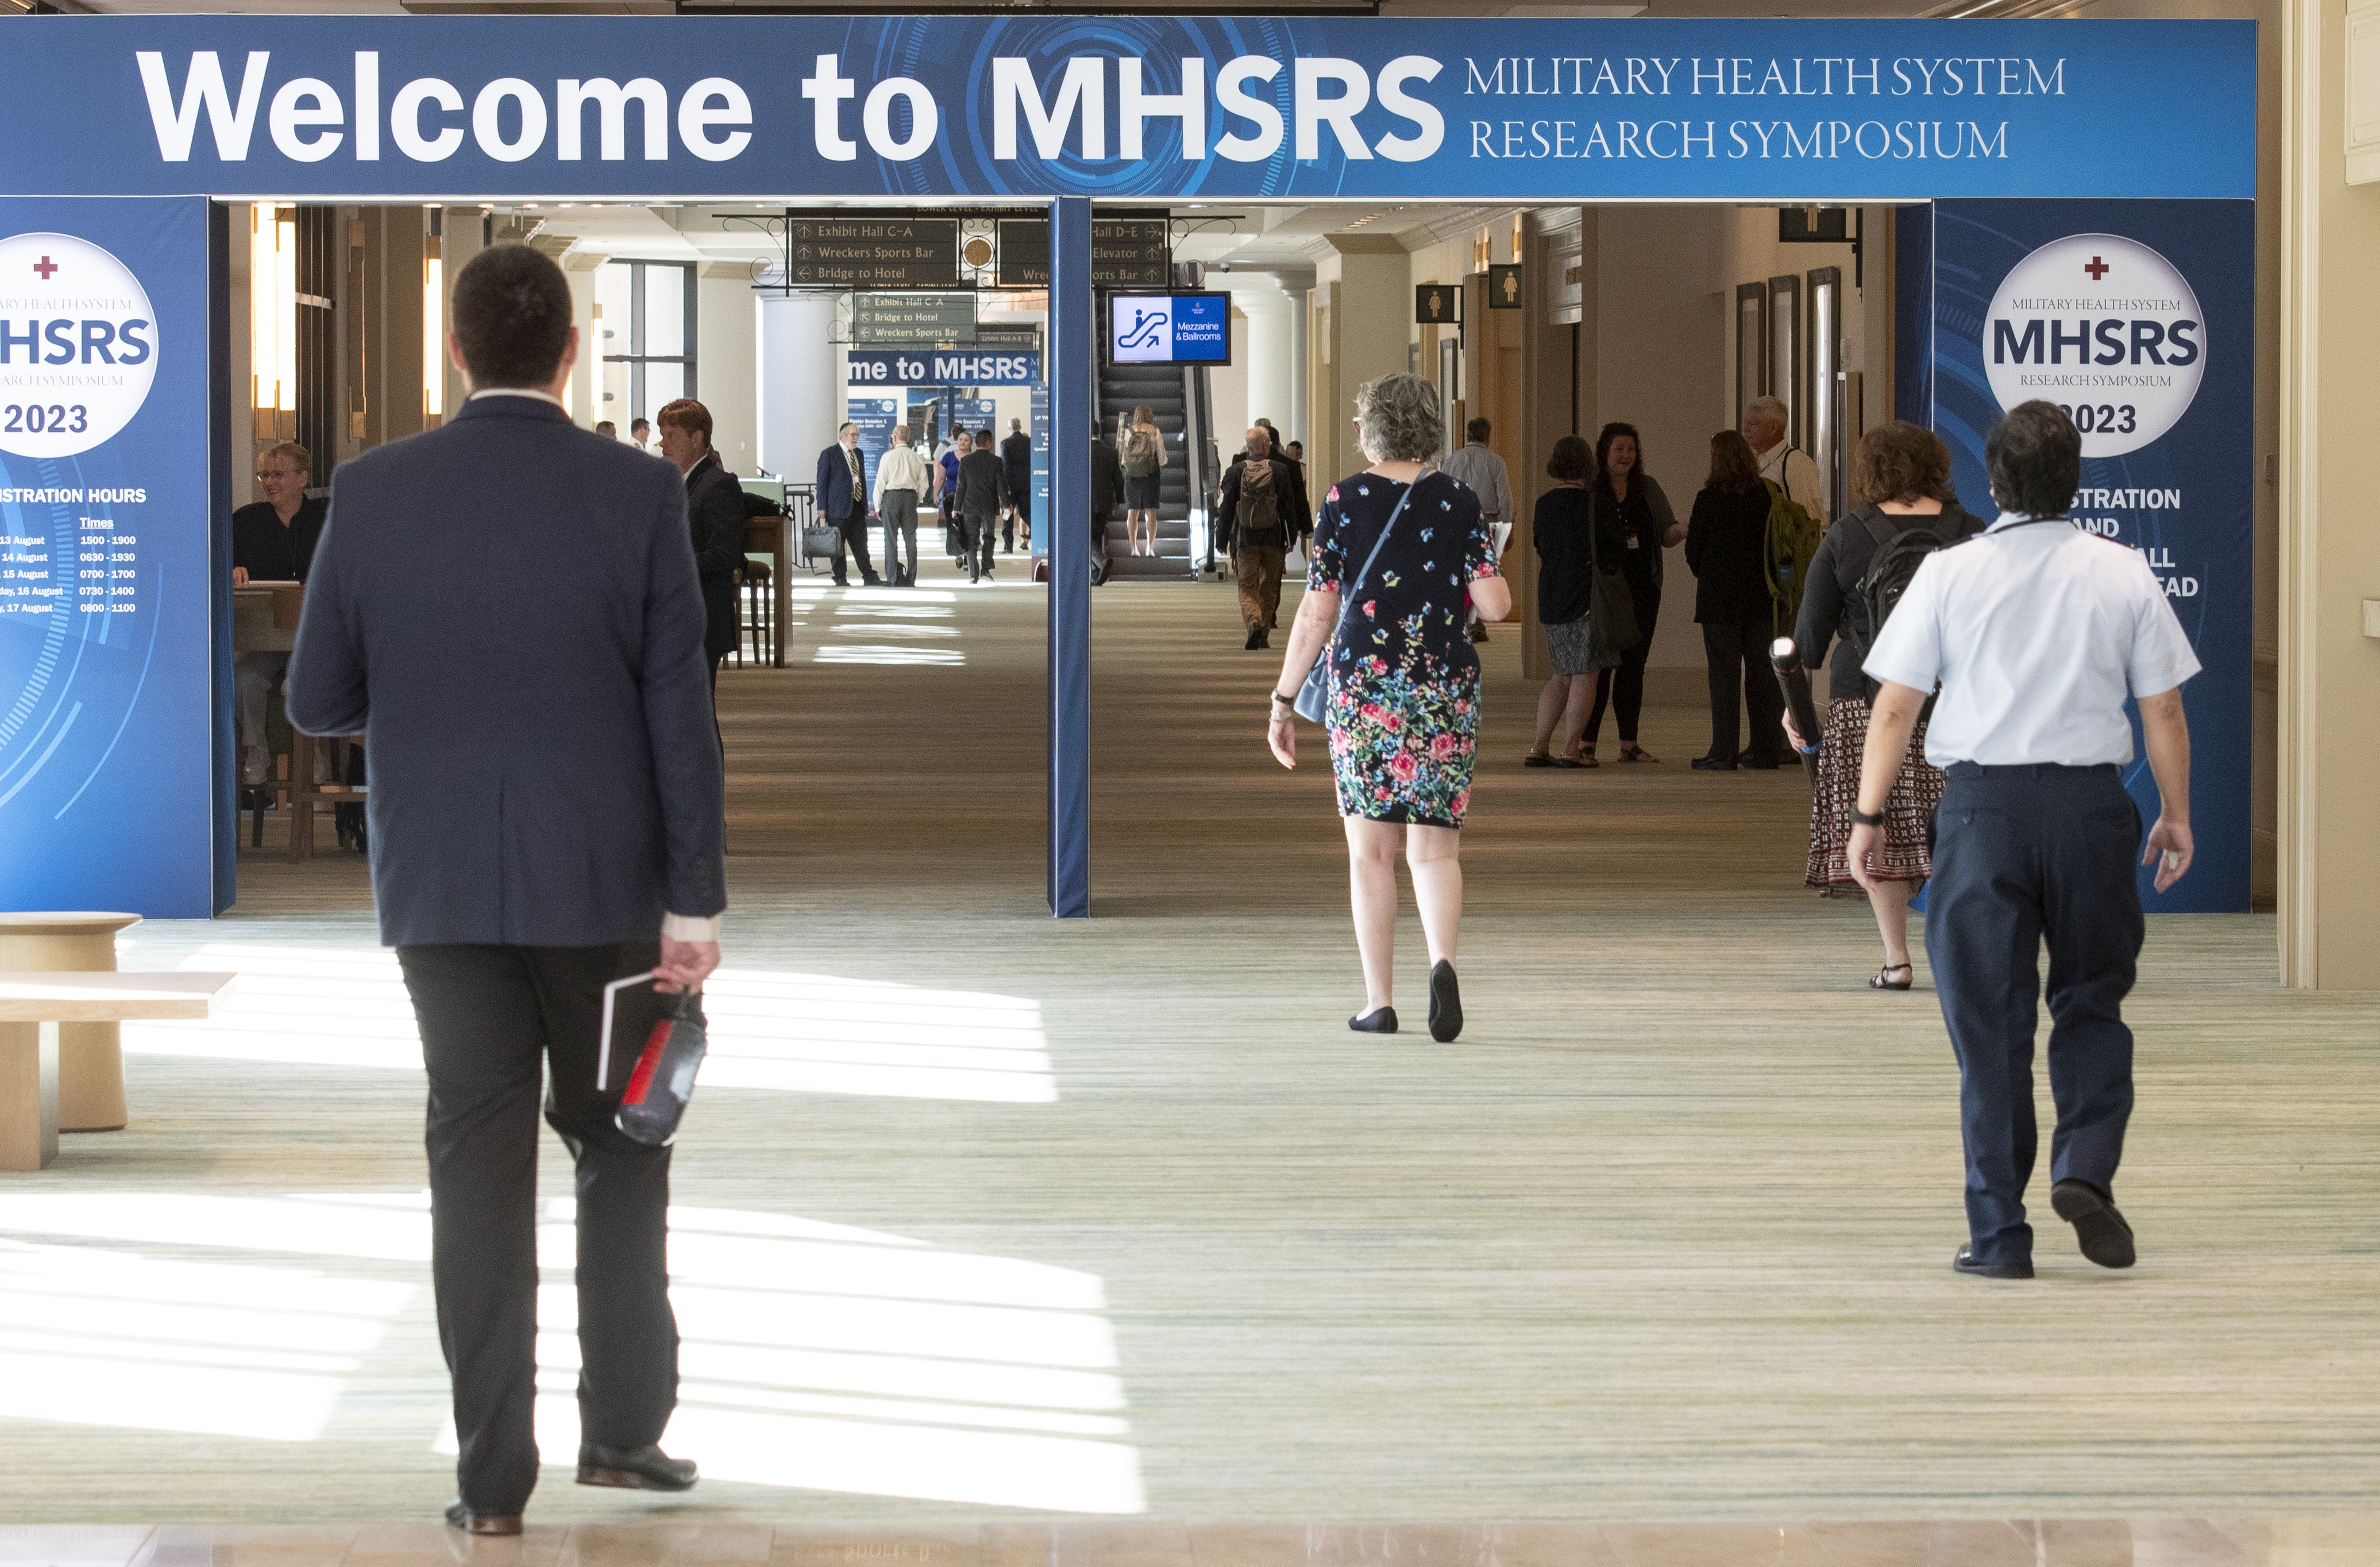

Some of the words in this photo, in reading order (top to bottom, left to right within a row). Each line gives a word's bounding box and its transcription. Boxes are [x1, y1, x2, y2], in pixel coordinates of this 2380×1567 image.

[1464, 57, 1683, 96] MILITARY
[1691, 57, 1880, 96] HEALTH
[1892, 57, 2067, 97] SYSTEM
[136, 51, 753, 163] Welcome
[801, 53, 939, 161] to
[993, 55, 1445, 163] MHSRS
[1469, 120, 1716, 159] RESEARCH
[1728, 120, 2009, 159] SYMPOSIUM
[818, 226, 857, 237] Exhibit
[862, 226, 884, 237] Hall
[819, 247, 870, 257] Wreckers
[875, 247, 911, 259] Sports
[916, 248, 934, 257] Bar
[1093, 248, 1138, 258] Elevator
[818, 268, 854, 280] Bridge
[859, 268, 870, 278] to
[875, 268, 905, 278] Hotel
[1120, 269, 1138, 280] Bar
[25, 299, 78, 310] HEALTH
[82, 299, 132, 310] SYSTEM
[875, 298, 903, 306] Exhibit
[907, 298, 922, 306] Hall
[2012, 299, 2072, 310] MILITARY
[2076, 299, 2129, 310] HEALTH
[2131, 299, 2181, 311] SYSTEM
[875, 313, 901, 323] Bridge
[915, 313, 938, 321] Hotel
[1177, 322, 1219, 330] Mezzanine
[875, 328, 913, 337] Wreckers
[916, 328, 942, 337] Sports
[946, 328, 958, 337] Bar
[1183, 332, 1221, 341] Ballrooms
[0, 319, 151, 365] HSRS
[1994, 319, 2199, 366] MHSRS
[896, 357, 925, 380] to
[935, 357, 1028, 380] MHSRS
[43, 375, 124, 385] SYMPOSIUM
[2020, 375, 2089, 386] RESEARCH
[2092, 375, 2171, 387] SYMPOSIUM
[4, 404, 88, 433] 2023
[88, 488, 146, 503] HOURS
[79, 517, 114, 529] Times
[2073, 518, 2119, 538] AND
[0, 536, 11, 545] 13
[13, 536, 45, 546] August
[80, 536, 105, 545] 1500
[111, 536, 136, 545] 1900
[2, 553, 14, 562] 14
[16, 553, 48, 563] August
[80, 553, 105, 562] 0630
[111, 553, 136, 562] 1930
[2137, 547, 2175, 568] LL
[3, 570, 16, 578] 15
[17, 570, 49, 580] August
[80, 570, 105, 579] 0700
[111, 570, 136, 579] 1700
[17, 586, 30, 595] 16
[32, 586, 63, 597] August
[79, 587, 104, 596] 0730
[110, 587, 134, 596] 1400
[7, 604, 20, 612] 17
[21, 604, 53, 614] August
[80, 604, 105, 613] 0800
[111, 604, 136, 613] 1100
